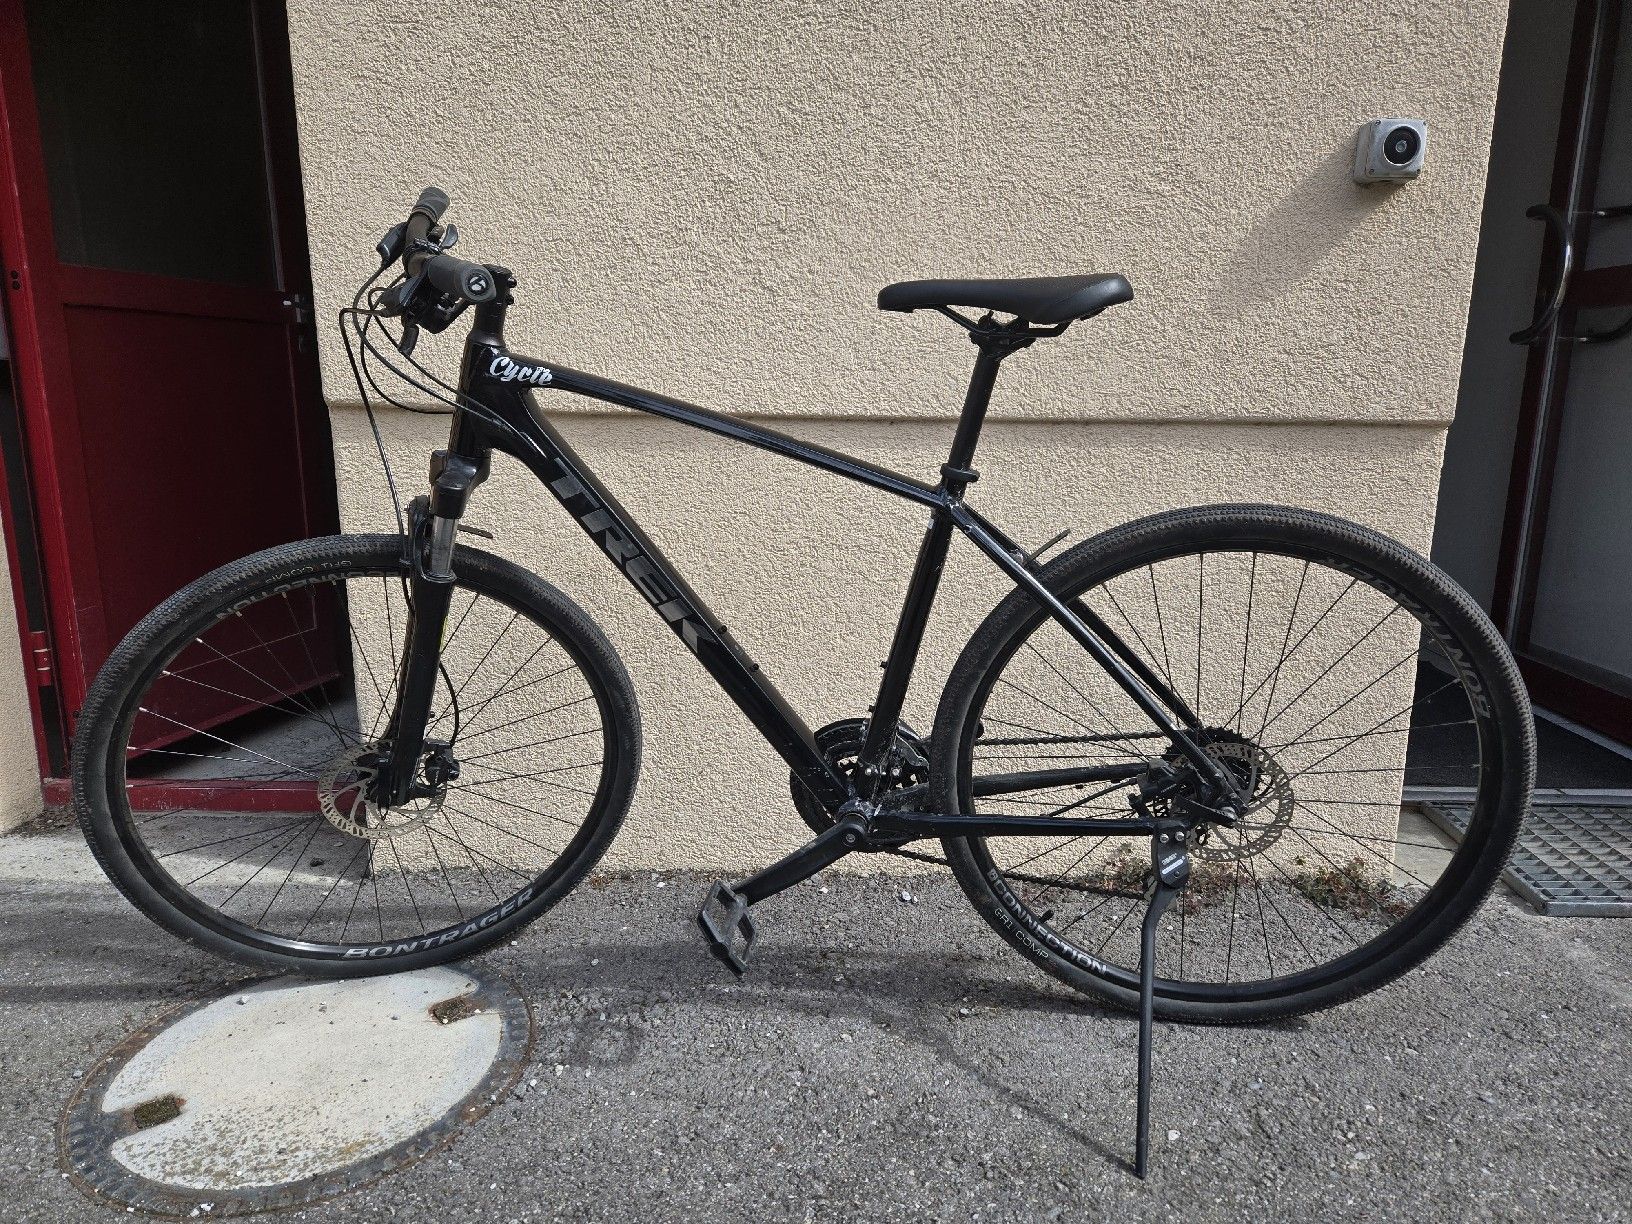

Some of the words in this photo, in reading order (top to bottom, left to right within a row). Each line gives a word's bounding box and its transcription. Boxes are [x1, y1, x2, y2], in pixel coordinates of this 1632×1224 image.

[489, 356, 553, 386] Cycle
[550, 457, 719, 653] TREK
[341, 888, 534, 959] BONTRAGER
[993, 881, 1108, 976] CONNECTION
[1015, 930, 1049, 960] COMP
